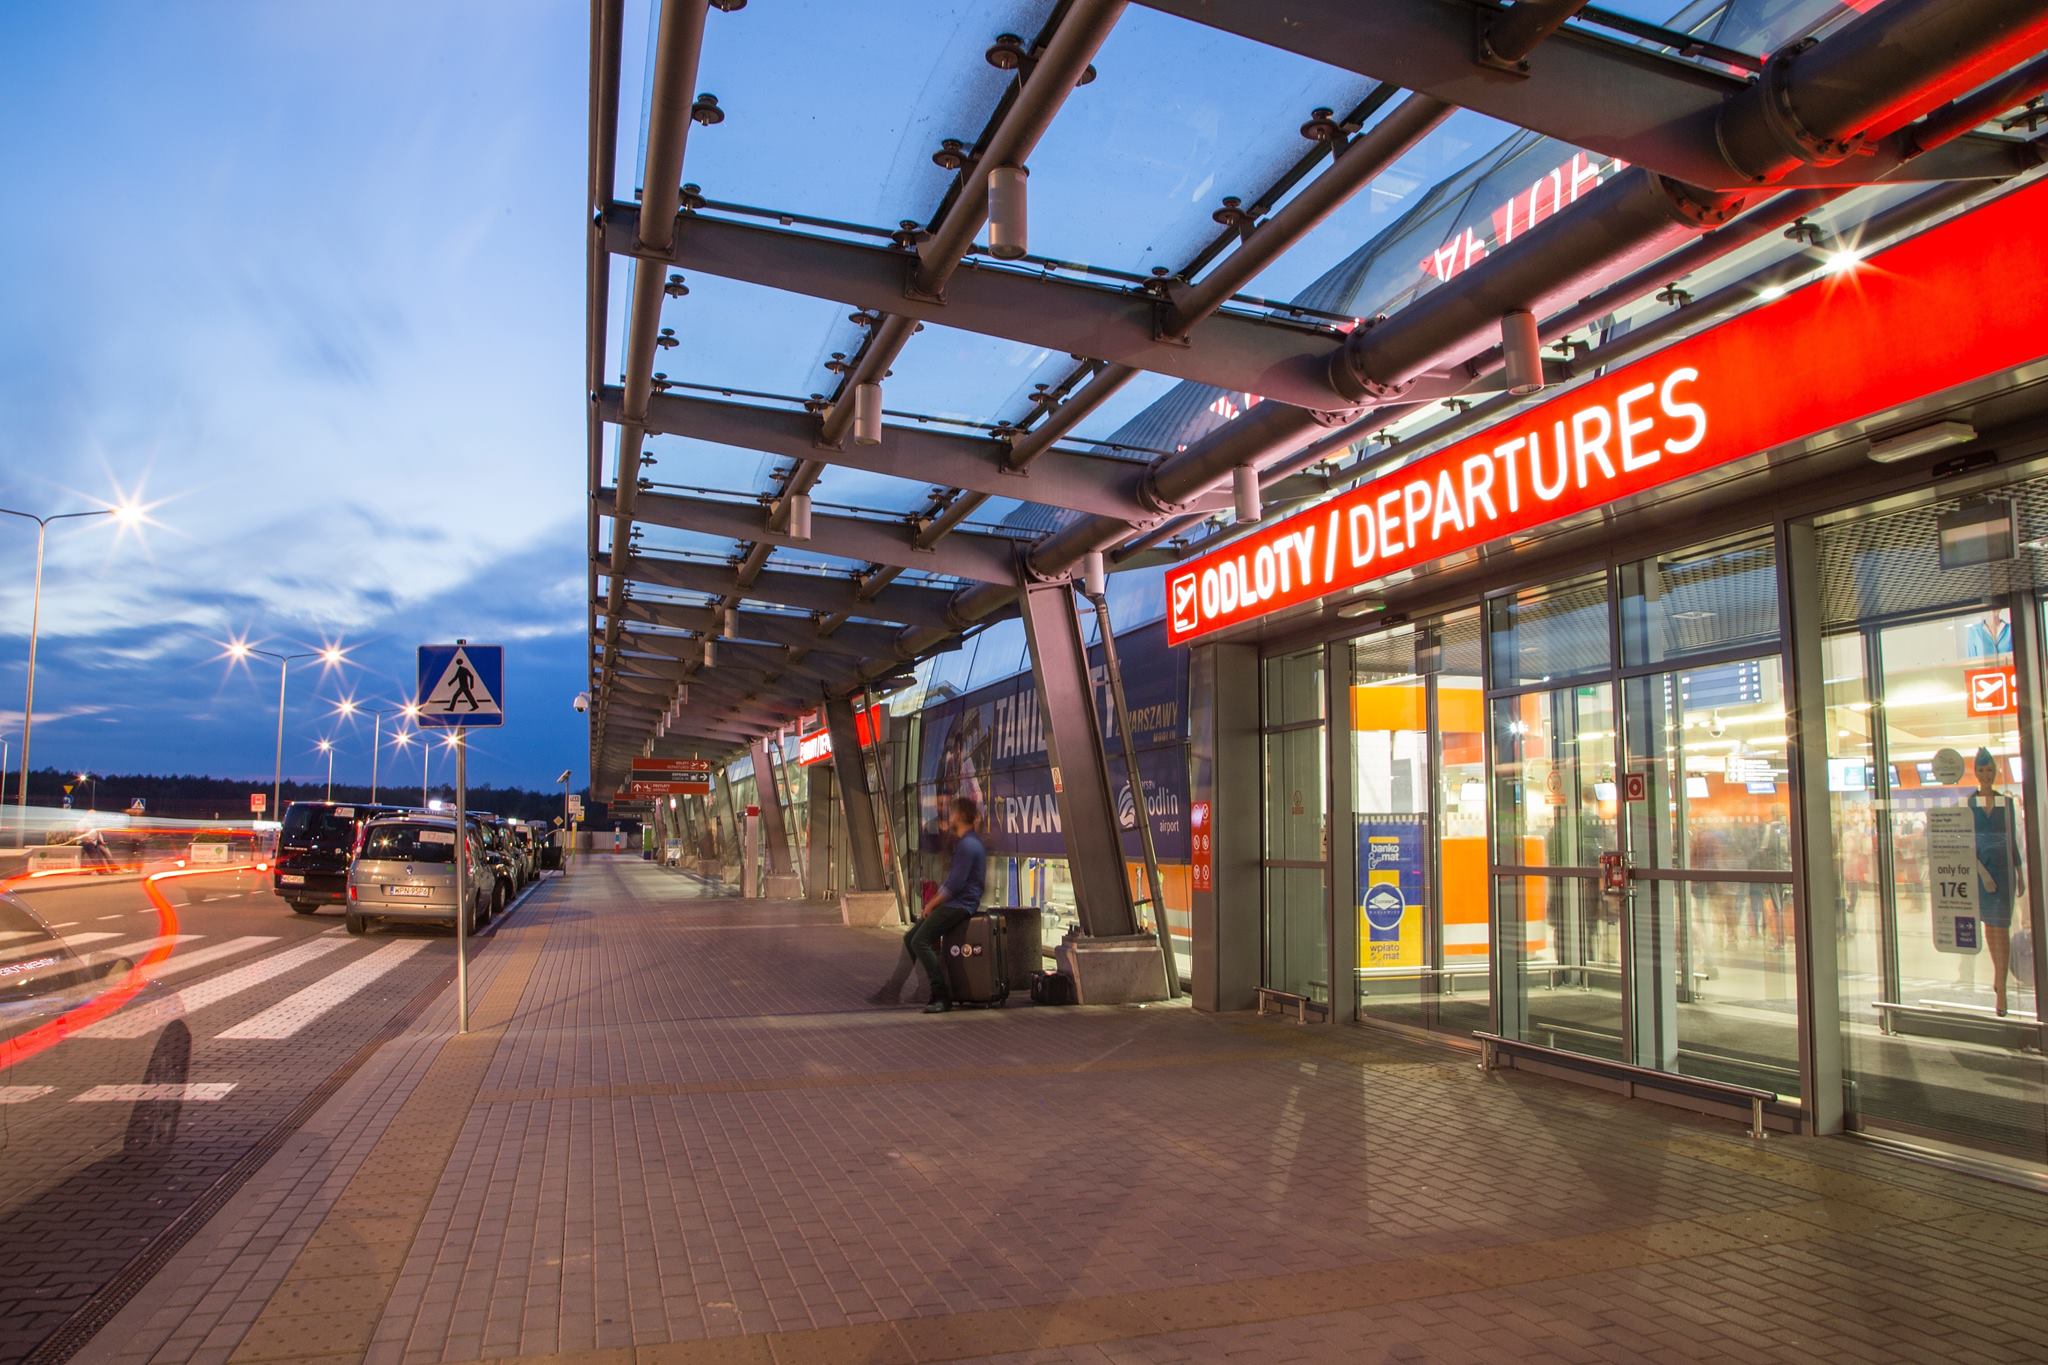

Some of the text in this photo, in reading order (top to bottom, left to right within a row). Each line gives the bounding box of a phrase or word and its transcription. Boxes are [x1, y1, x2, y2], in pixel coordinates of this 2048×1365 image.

[1200, 522, 1317, 620] ODLOTY
[1348, 366, 1708, 569] DEPARTURES
[1144, 786, 1179, 816] odlin
[1159, 819, 1180, 835] airport
[1371, 843, 1400, 852] banko
[1381, 853, 1400, 861] mat
[1937, 864, 1970, 877] only for
[1939, 882, 1968, 898] 17€
